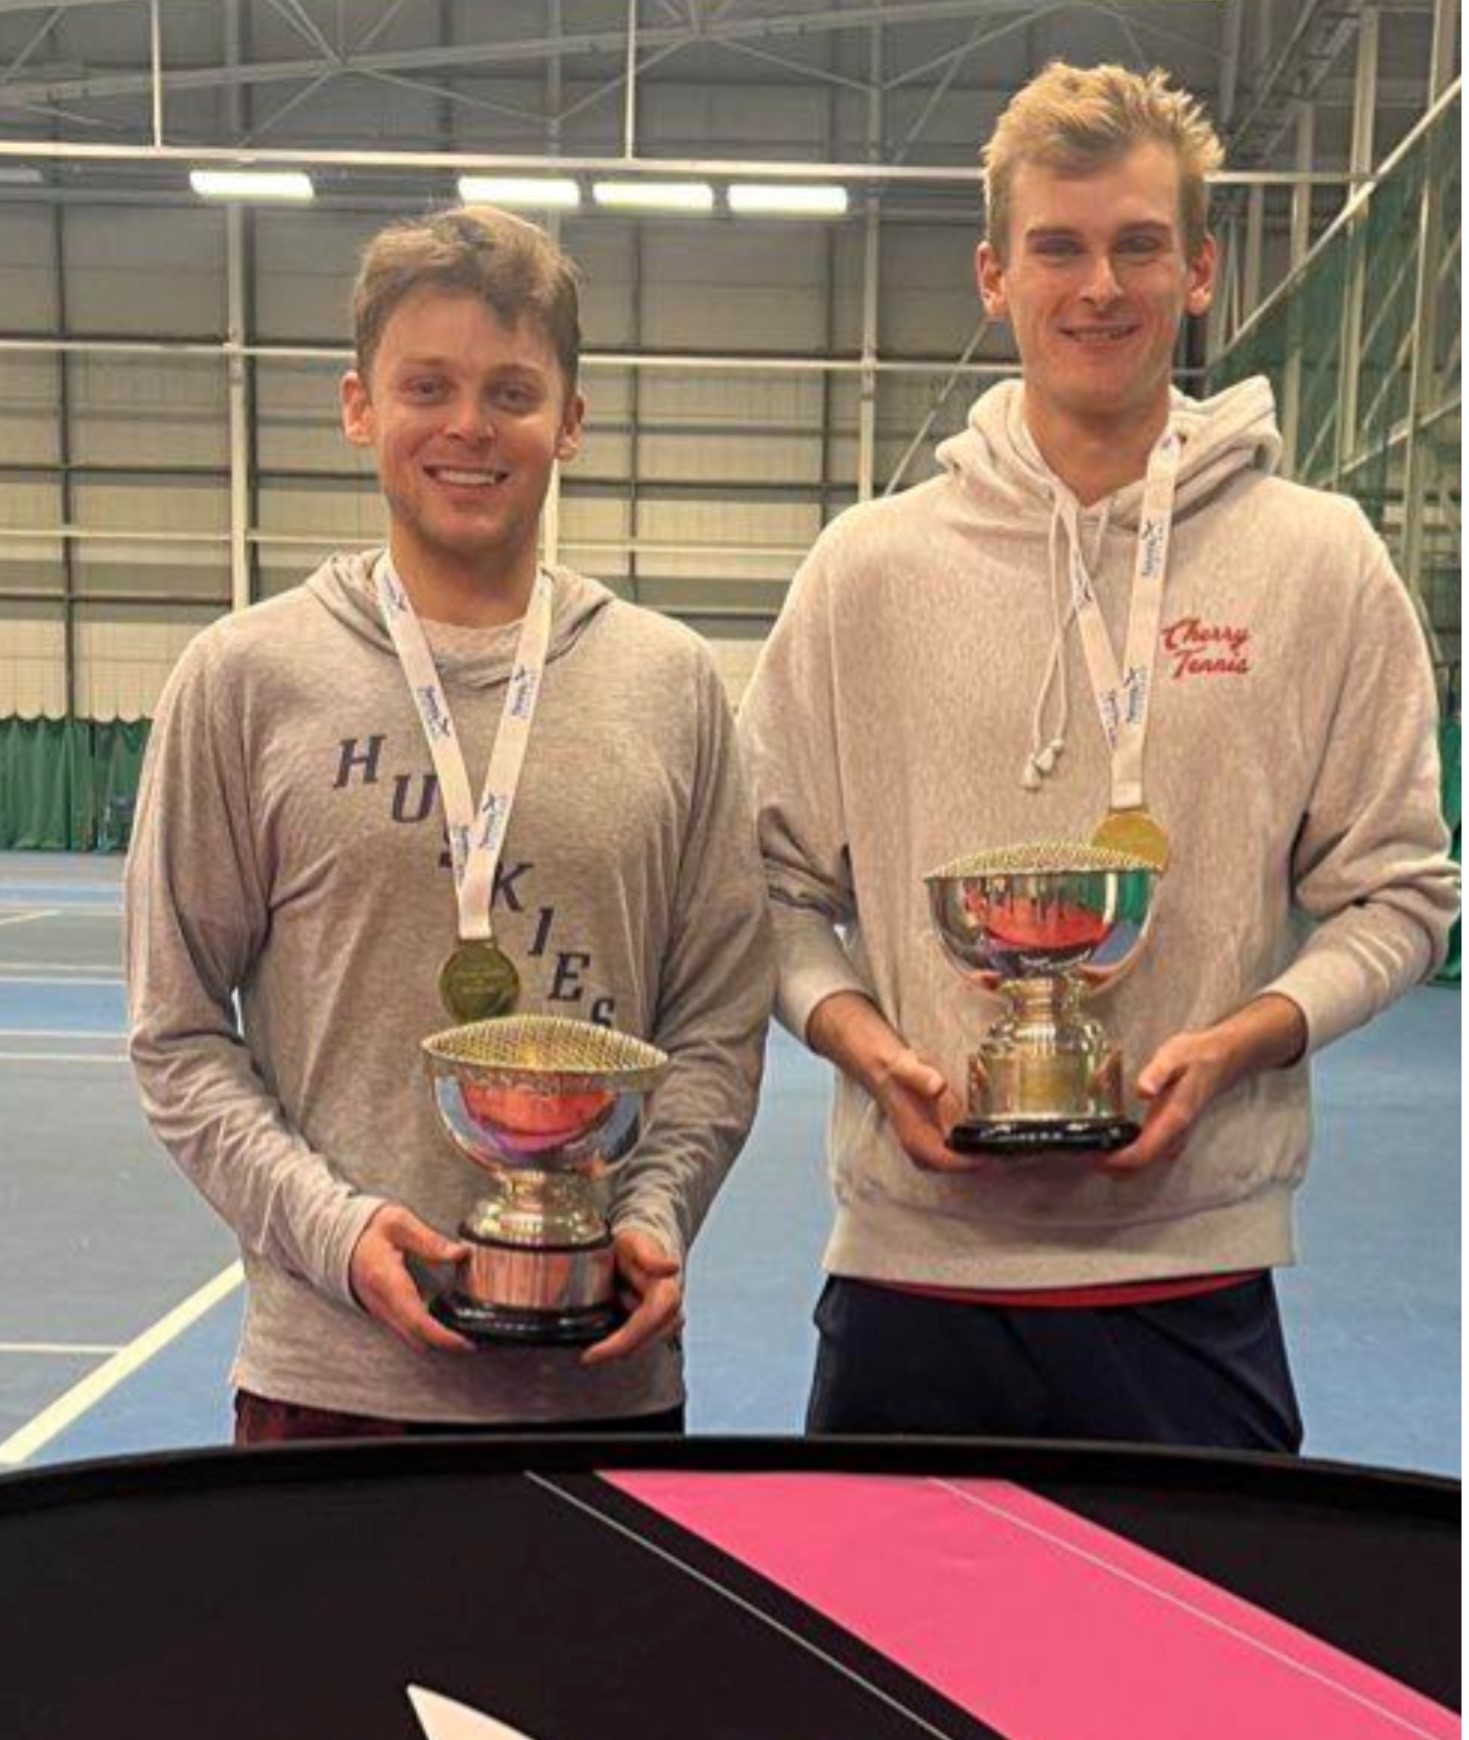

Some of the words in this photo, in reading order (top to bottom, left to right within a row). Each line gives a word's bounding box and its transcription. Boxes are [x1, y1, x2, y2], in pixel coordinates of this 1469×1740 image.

[1161, 617, 1249, 658] Cherry
[1173, 646, 1249, 680] Tennis
[333, 734, 615, 1028] HUKIES
